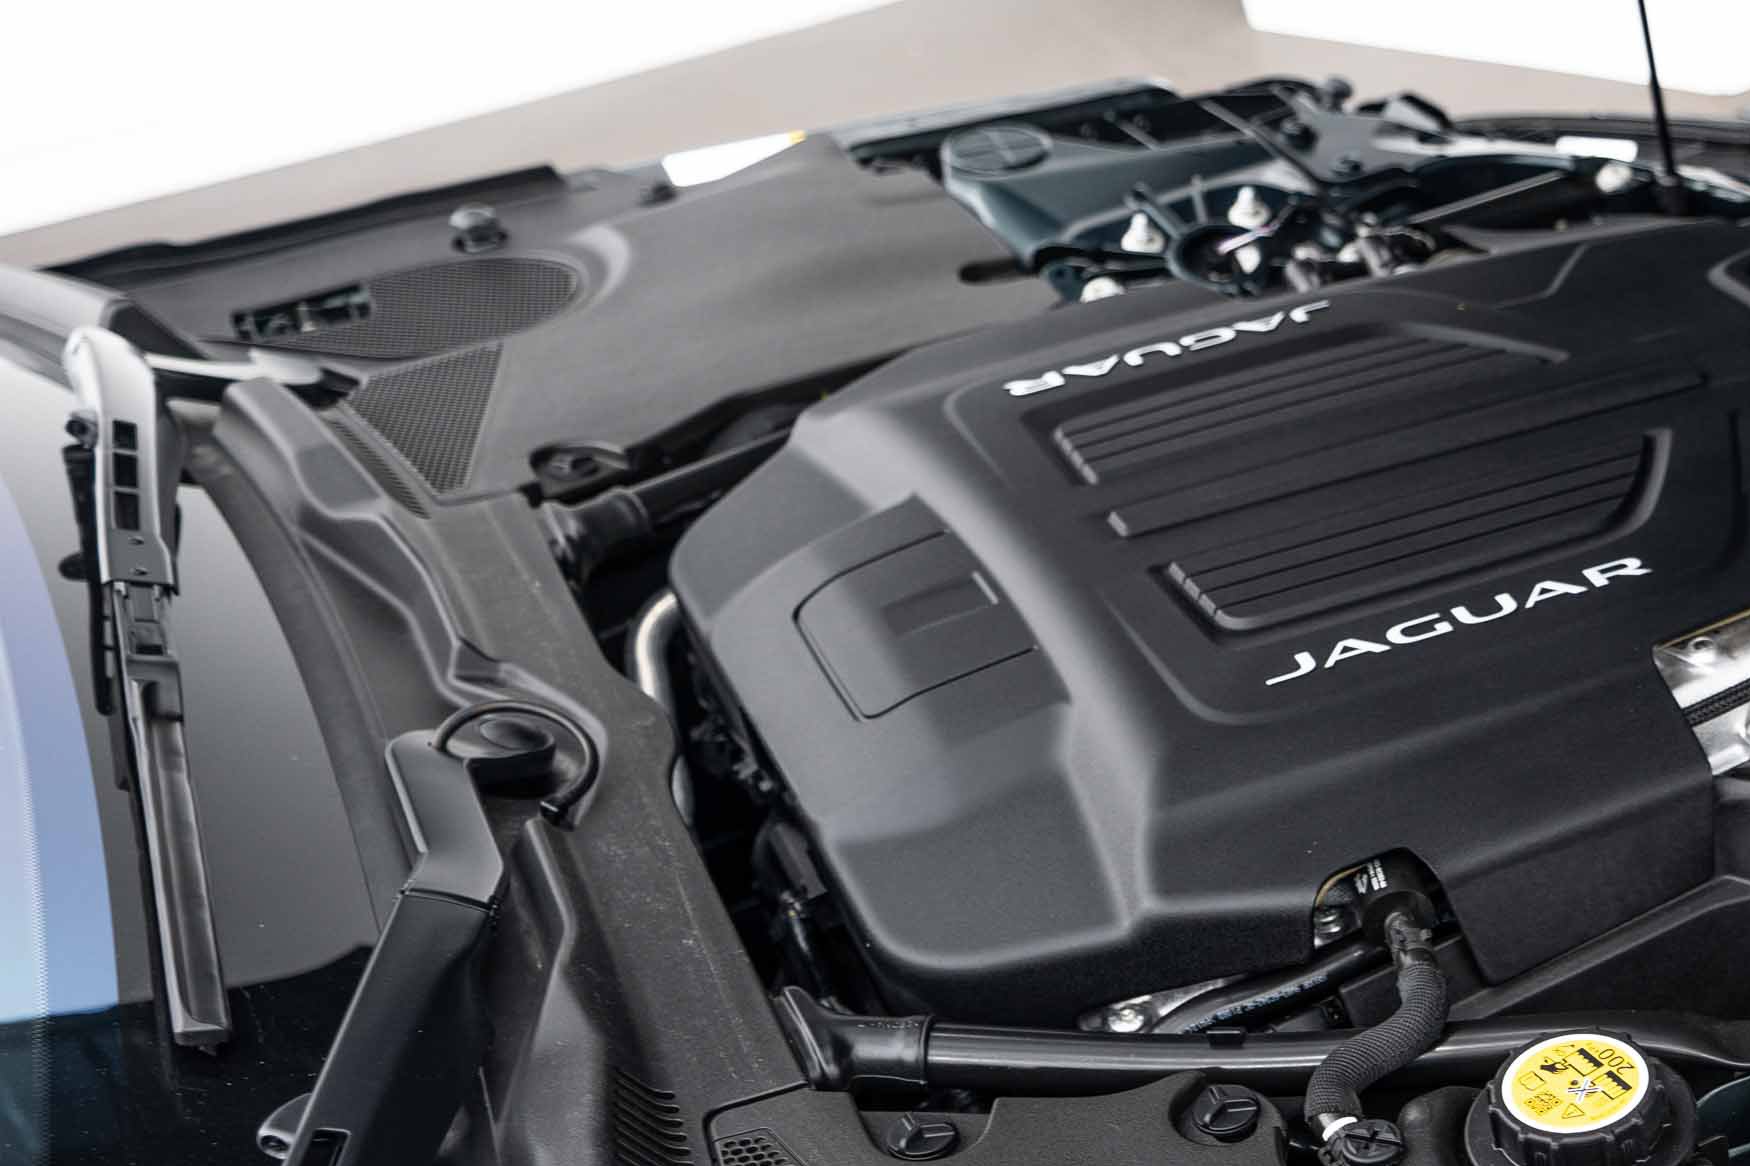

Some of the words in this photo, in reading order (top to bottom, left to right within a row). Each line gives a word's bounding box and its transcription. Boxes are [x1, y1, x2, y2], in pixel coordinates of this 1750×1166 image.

[1003, 299, 1330, 397] JAGUAR
[1265, 556, 1653, 686] JAGUAR
[1598, 1048, 1635, 1075] 200
